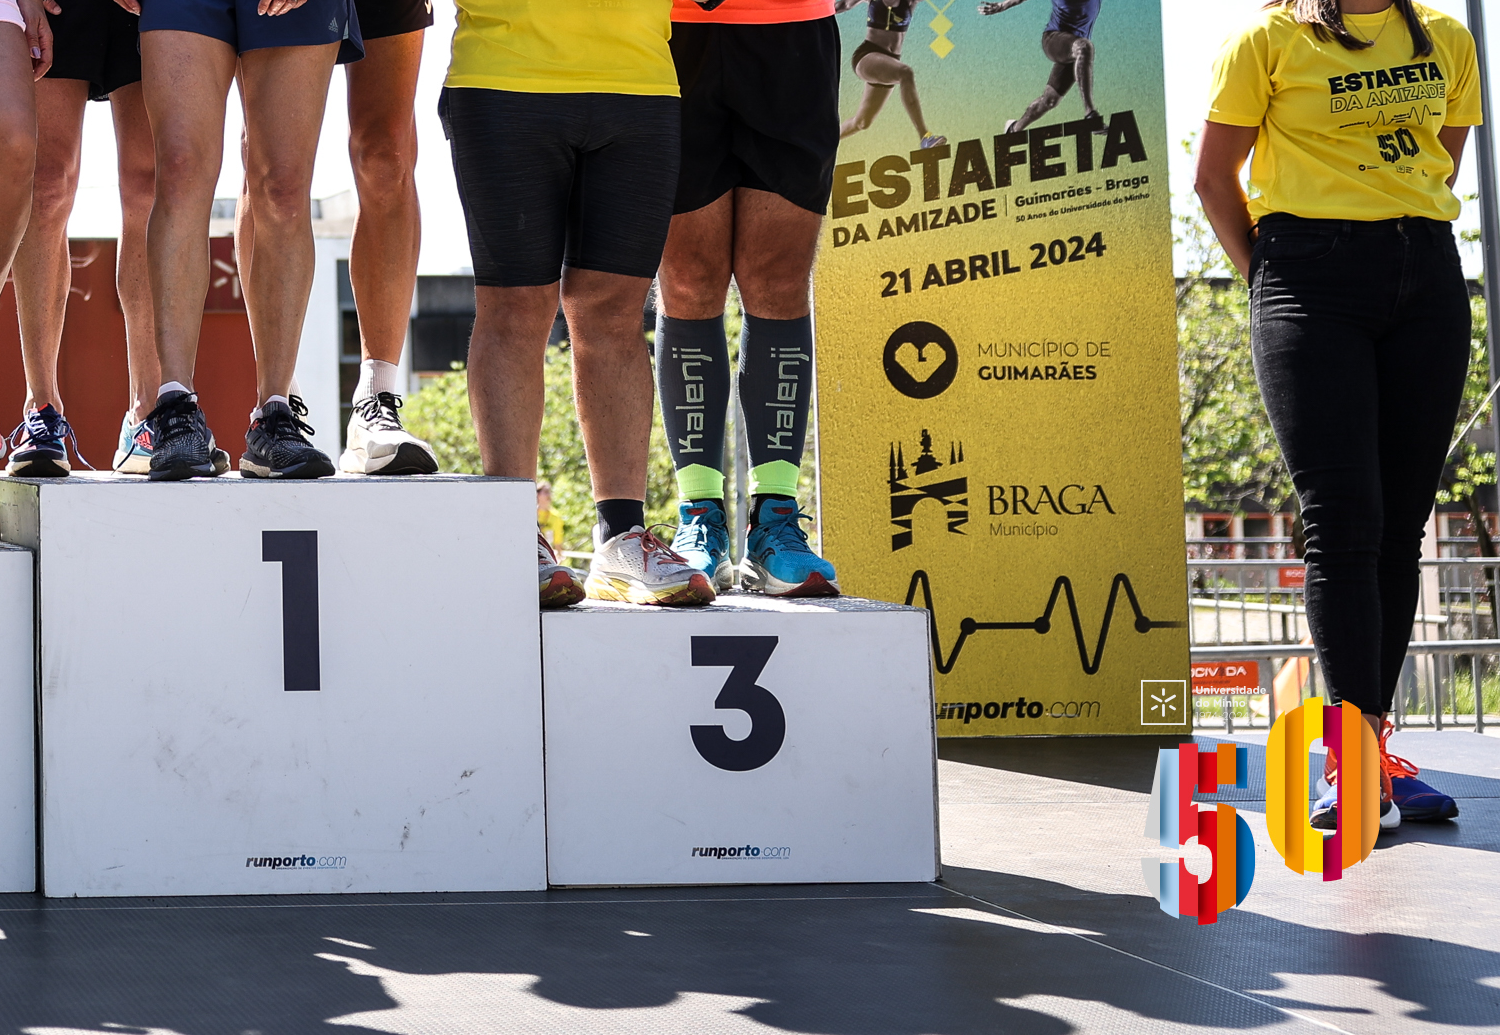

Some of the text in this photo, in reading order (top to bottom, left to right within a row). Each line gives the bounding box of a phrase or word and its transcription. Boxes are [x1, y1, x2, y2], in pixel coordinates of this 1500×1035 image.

[1327, 61, 1445, 96] ESTAFETA
[1331, 82, 1446, 114] DA AMIZADE
[1376, 127, 1420, 164] 50
[831, 109, 1148, 219] ESTAFETA
[1015, 185, 1092, 208] Guimarães
[1105, 175, 1150, 191] Braga
[1015, 215, 1026, 223] 50
[1027, 212, 1047, 221] Anos
[1060, 199, 1112, 215] Universidade
[1113, 196, 1123, 205] do
[1124, 192, 1150, 204] Minho
[832, 198, 997, 248] DA AMIZADE
[880, 231, 1107, 298] 21 ABRIL 2024
[977, 339, 1111, 358] MUNICÍPIO DE
[978, 361, 1097, 381] GUIMARÃES
[986, 484, 1117, 516] BRAGA
[989, 522, 1058, 539] Município
[261, 530, 321, 692] 1
[689, 635, 787, 772] 3
[934, 697, 1101, 725] unporto.com
